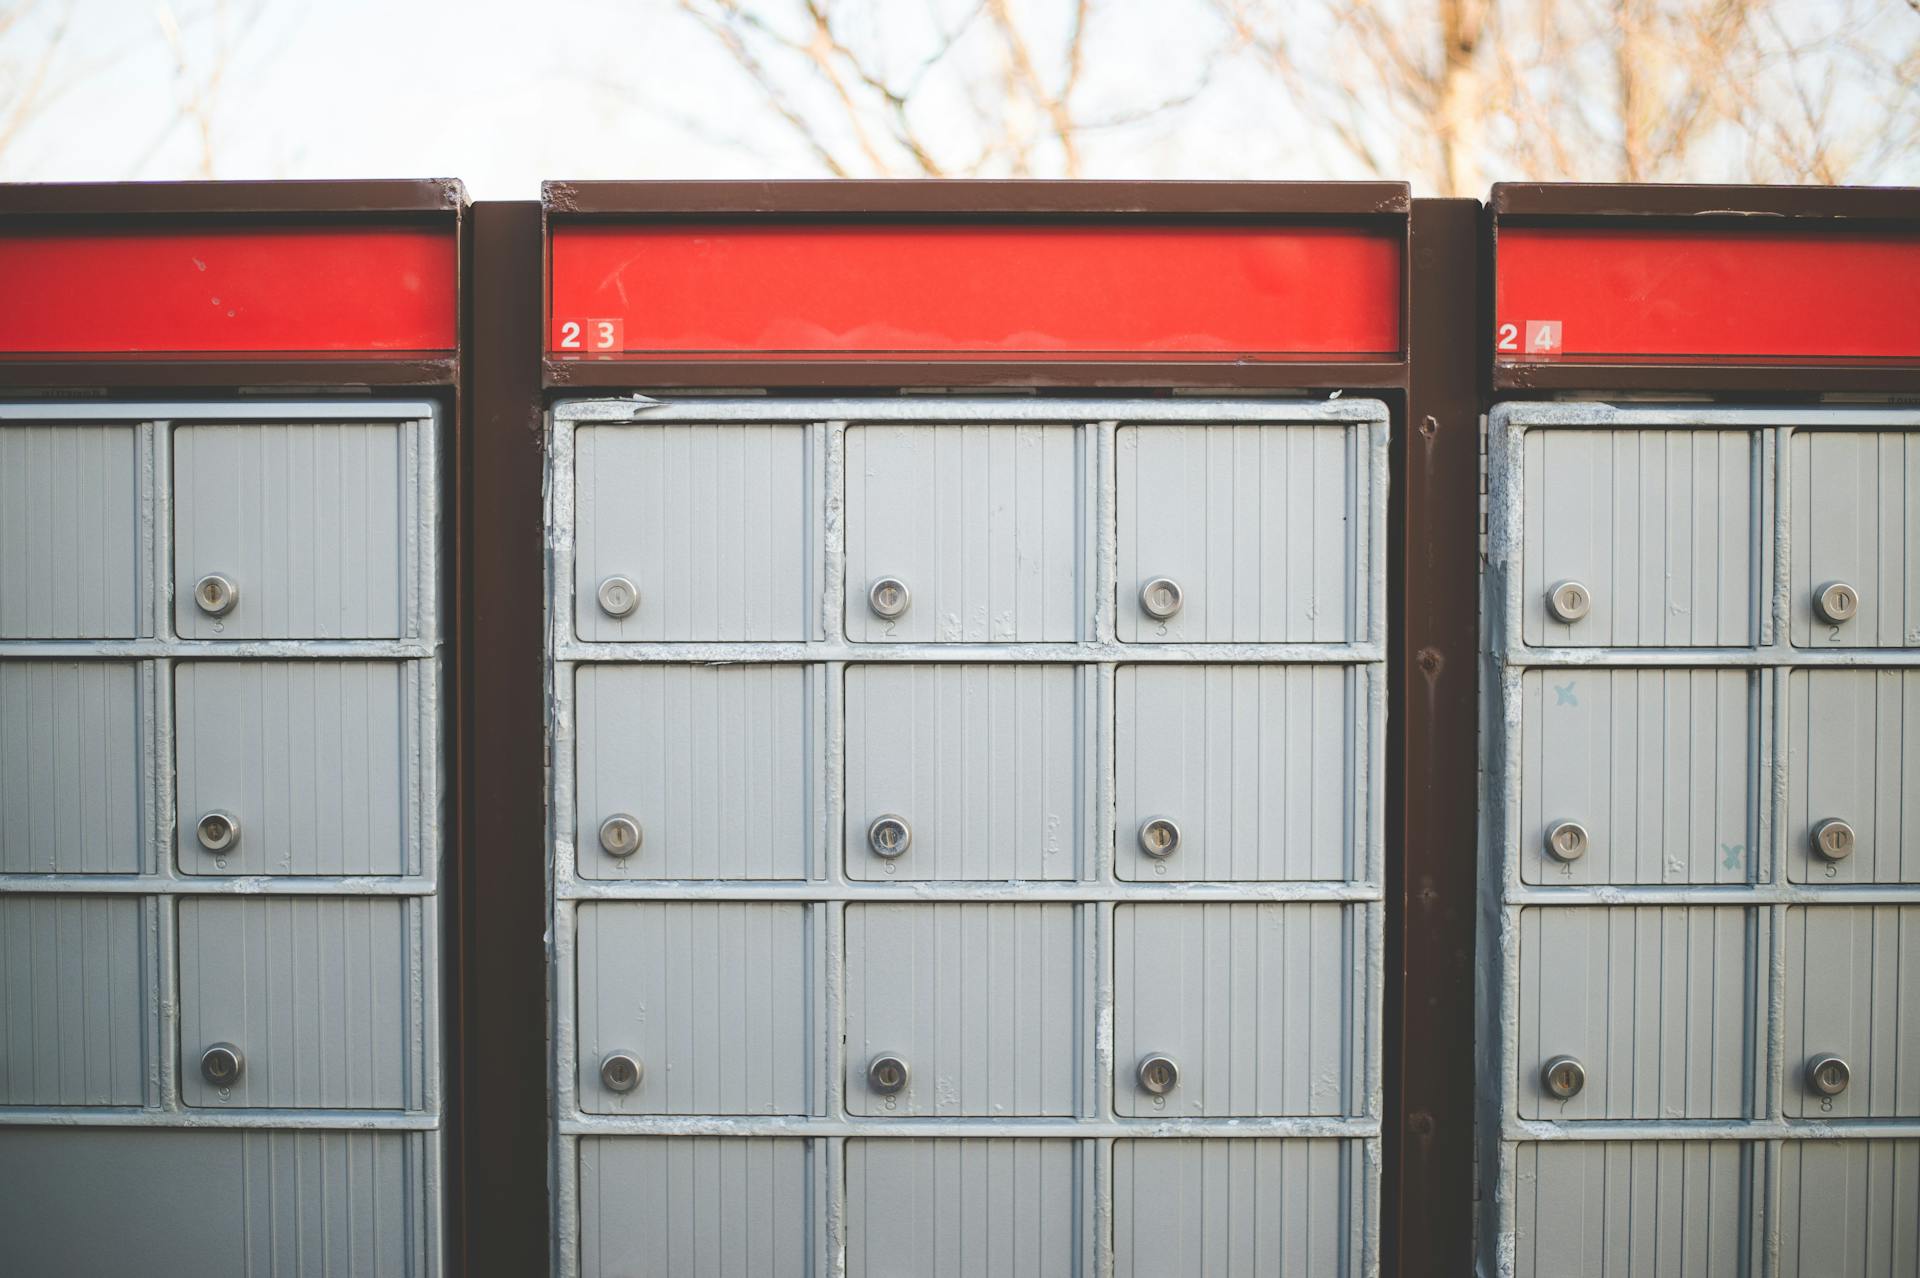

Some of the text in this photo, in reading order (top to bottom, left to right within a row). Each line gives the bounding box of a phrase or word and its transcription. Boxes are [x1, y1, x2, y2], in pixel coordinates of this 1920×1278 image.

[884, 621, 896, 637] 2
[1156, 620, 1167, 636] 3
[1829, 626, 1841, 642] 2
[215, 855, 227, 869] 6
[616, 858, 628, 874] 4
[1825, 862, 1837, 877] 5
[1560, 863, 1572, 880] 4
[885, 1095, 896, 1110] 8
[1153, 1096, 1166, 1112] 9
[1821, 1097, 1833, 1112] 8
